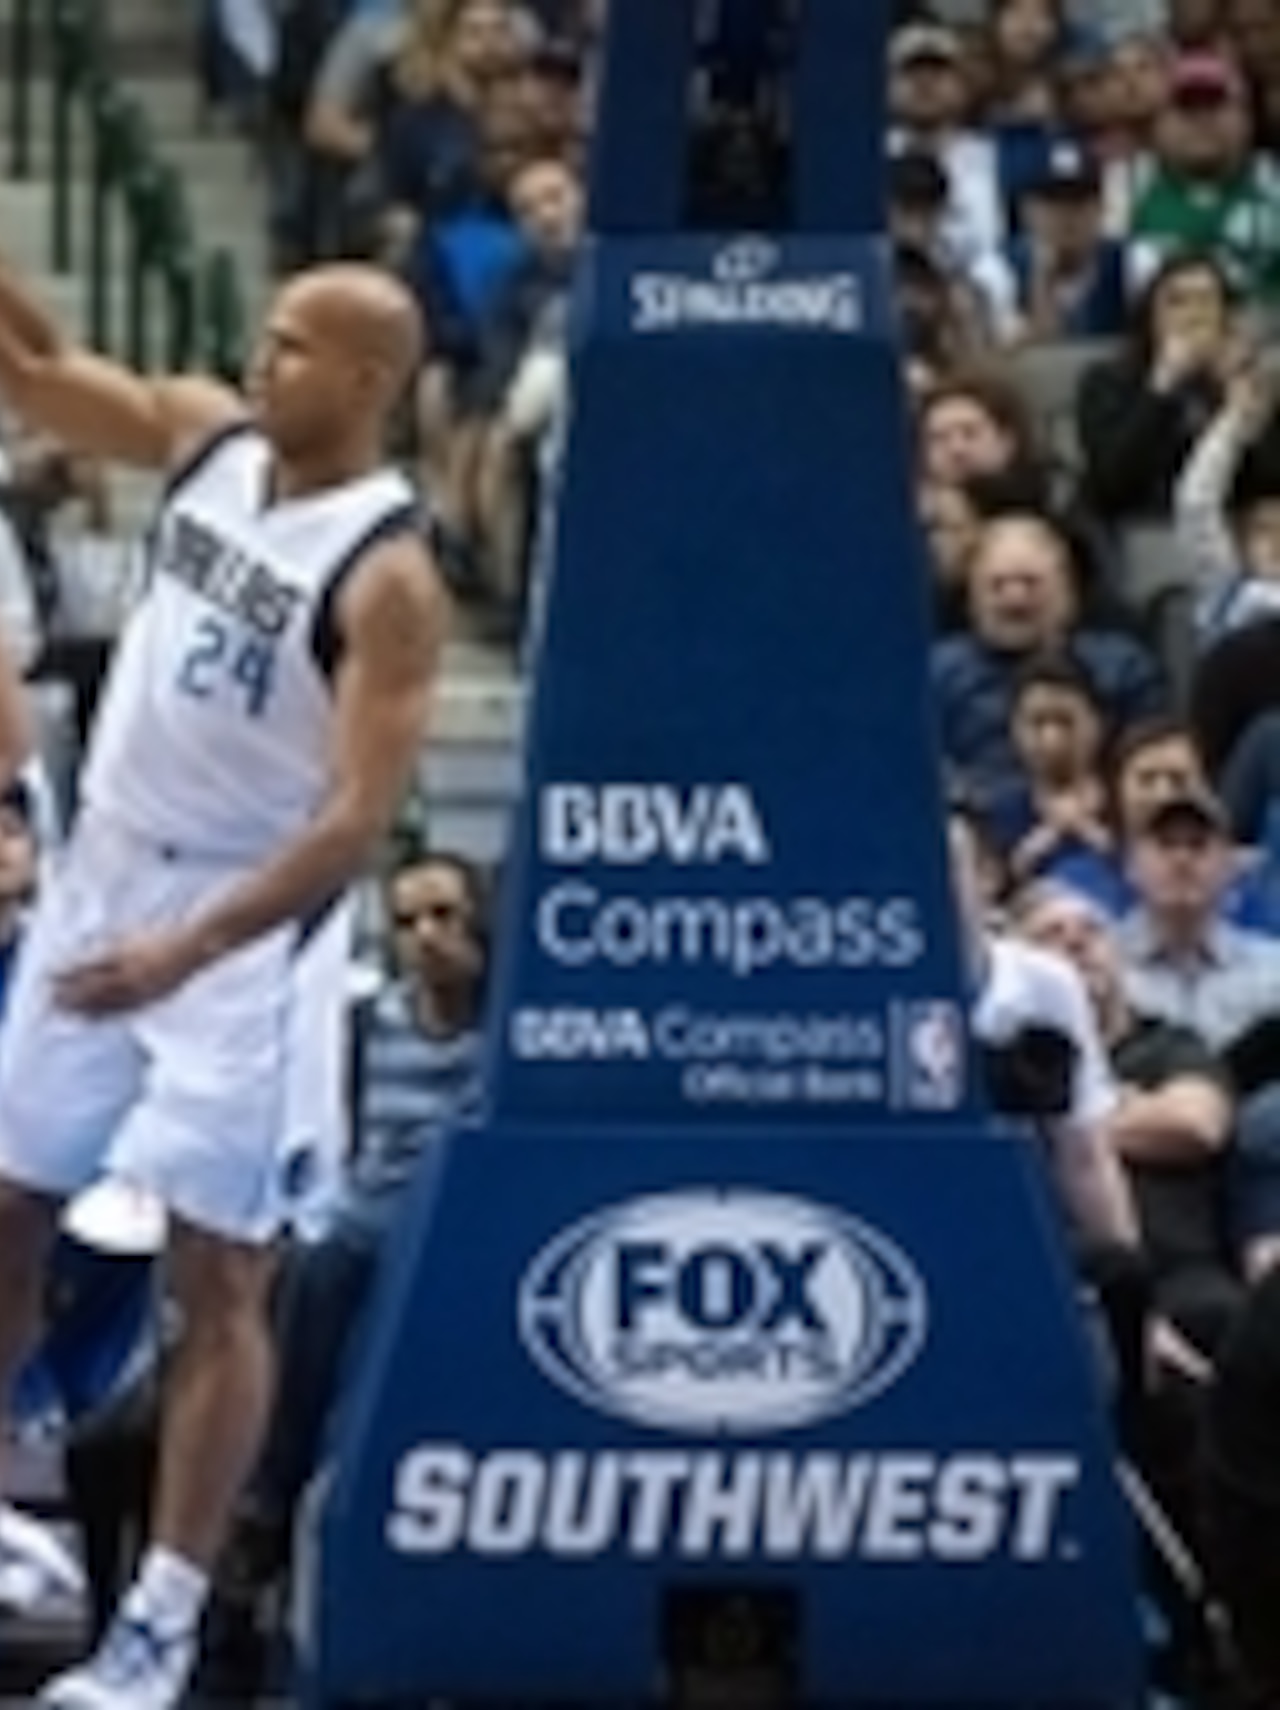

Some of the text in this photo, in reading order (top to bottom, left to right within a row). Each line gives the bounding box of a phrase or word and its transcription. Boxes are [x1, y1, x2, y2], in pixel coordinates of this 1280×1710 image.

[631, 273, 863, 332] SPALDING
[176, 616, 276, 719] 24
[539, 783, 771, 865] BBVA
[536, 880, 924, 976] Compass
[511, 1003, 885, 1063] BBVA Compass
[615, 1240, 828, 1331] FOX
[612, 1340, 840, 1383] SPORTS
[387, 1448, 1080, 1560] SOUTHWEST
